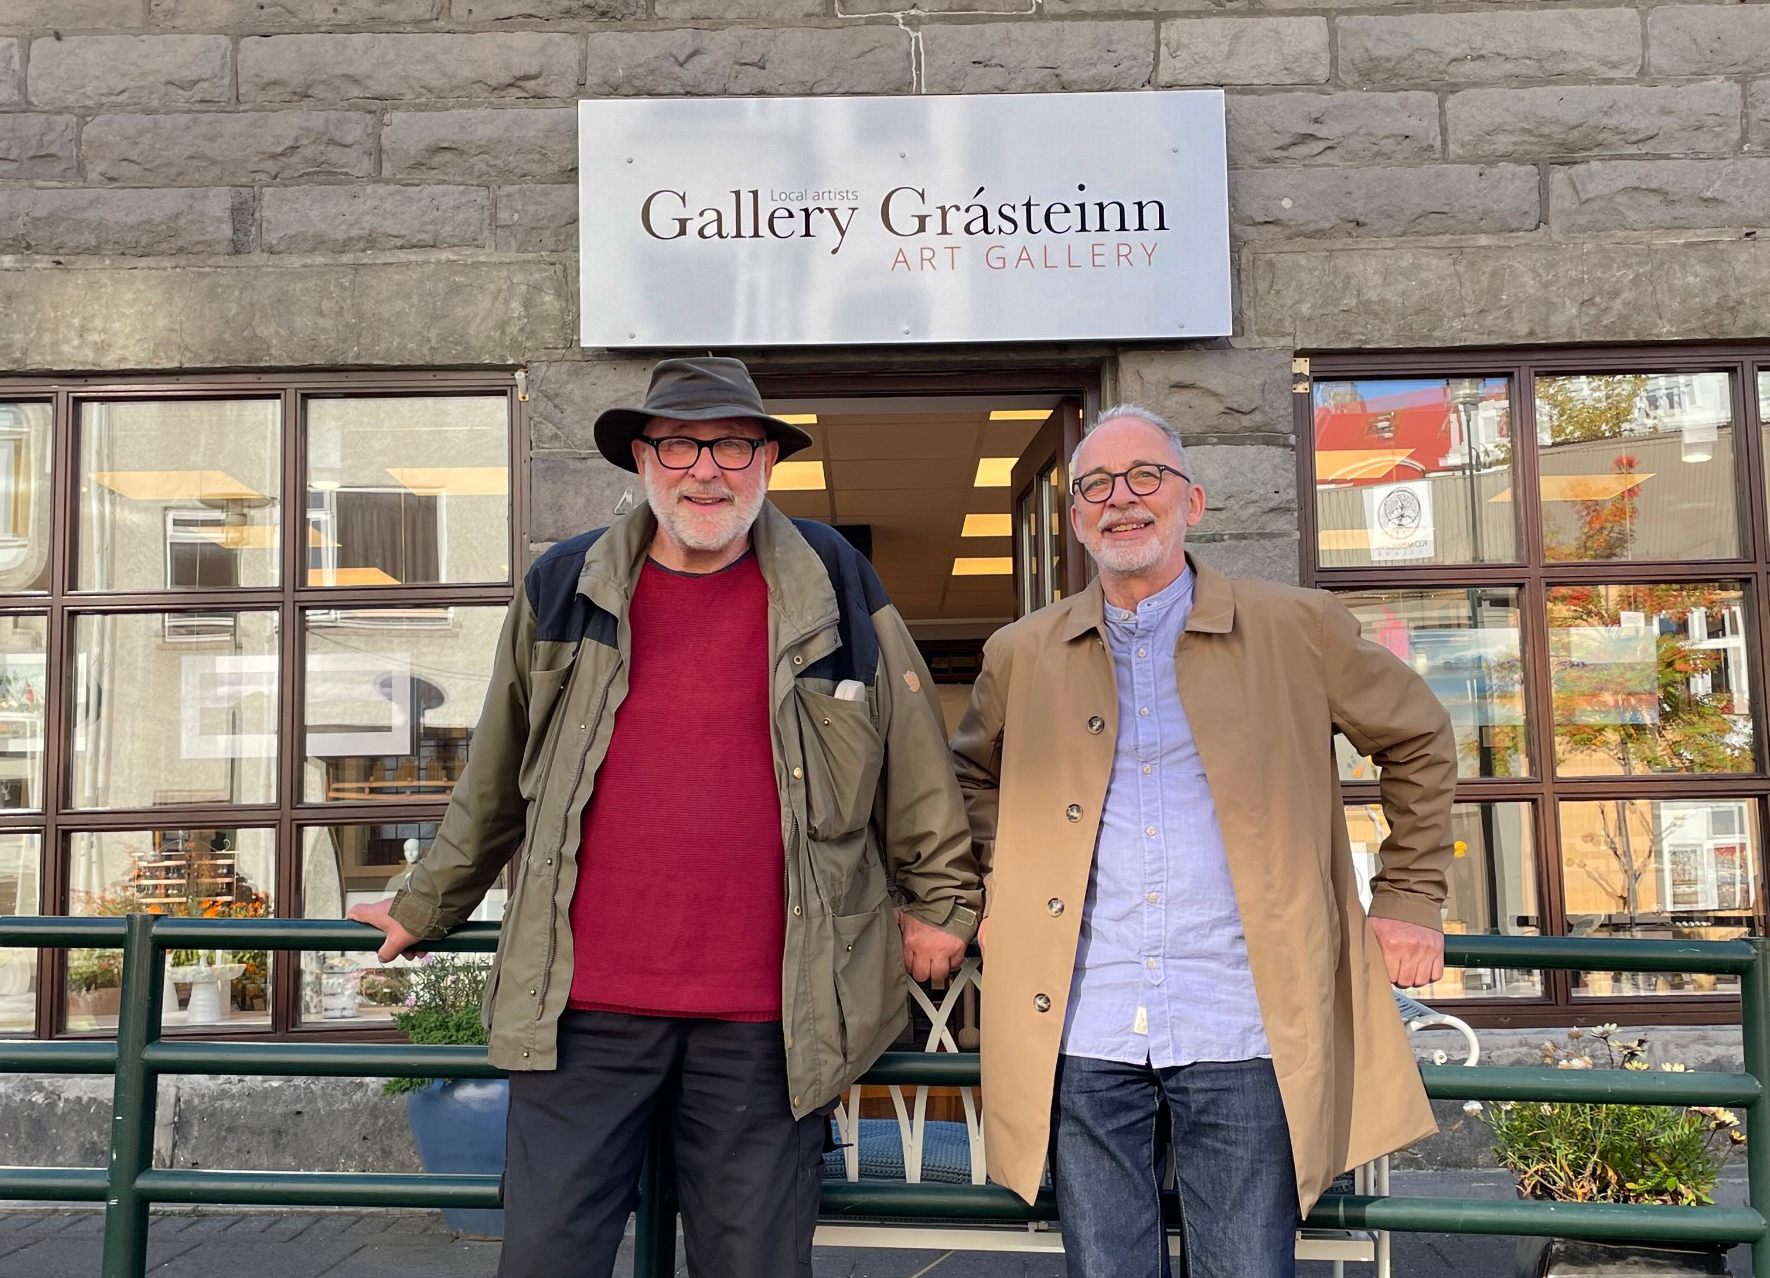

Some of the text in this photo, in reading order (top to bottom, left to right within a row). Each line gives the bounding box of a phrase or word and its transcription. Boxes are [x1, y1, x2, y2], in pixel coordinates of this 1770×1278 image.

[770, 187, 860, 202] Local artists
[641, 183, 1171, 255] Gallery Grásteinn
[891, 242, 1159, 272] ART GALLERY
